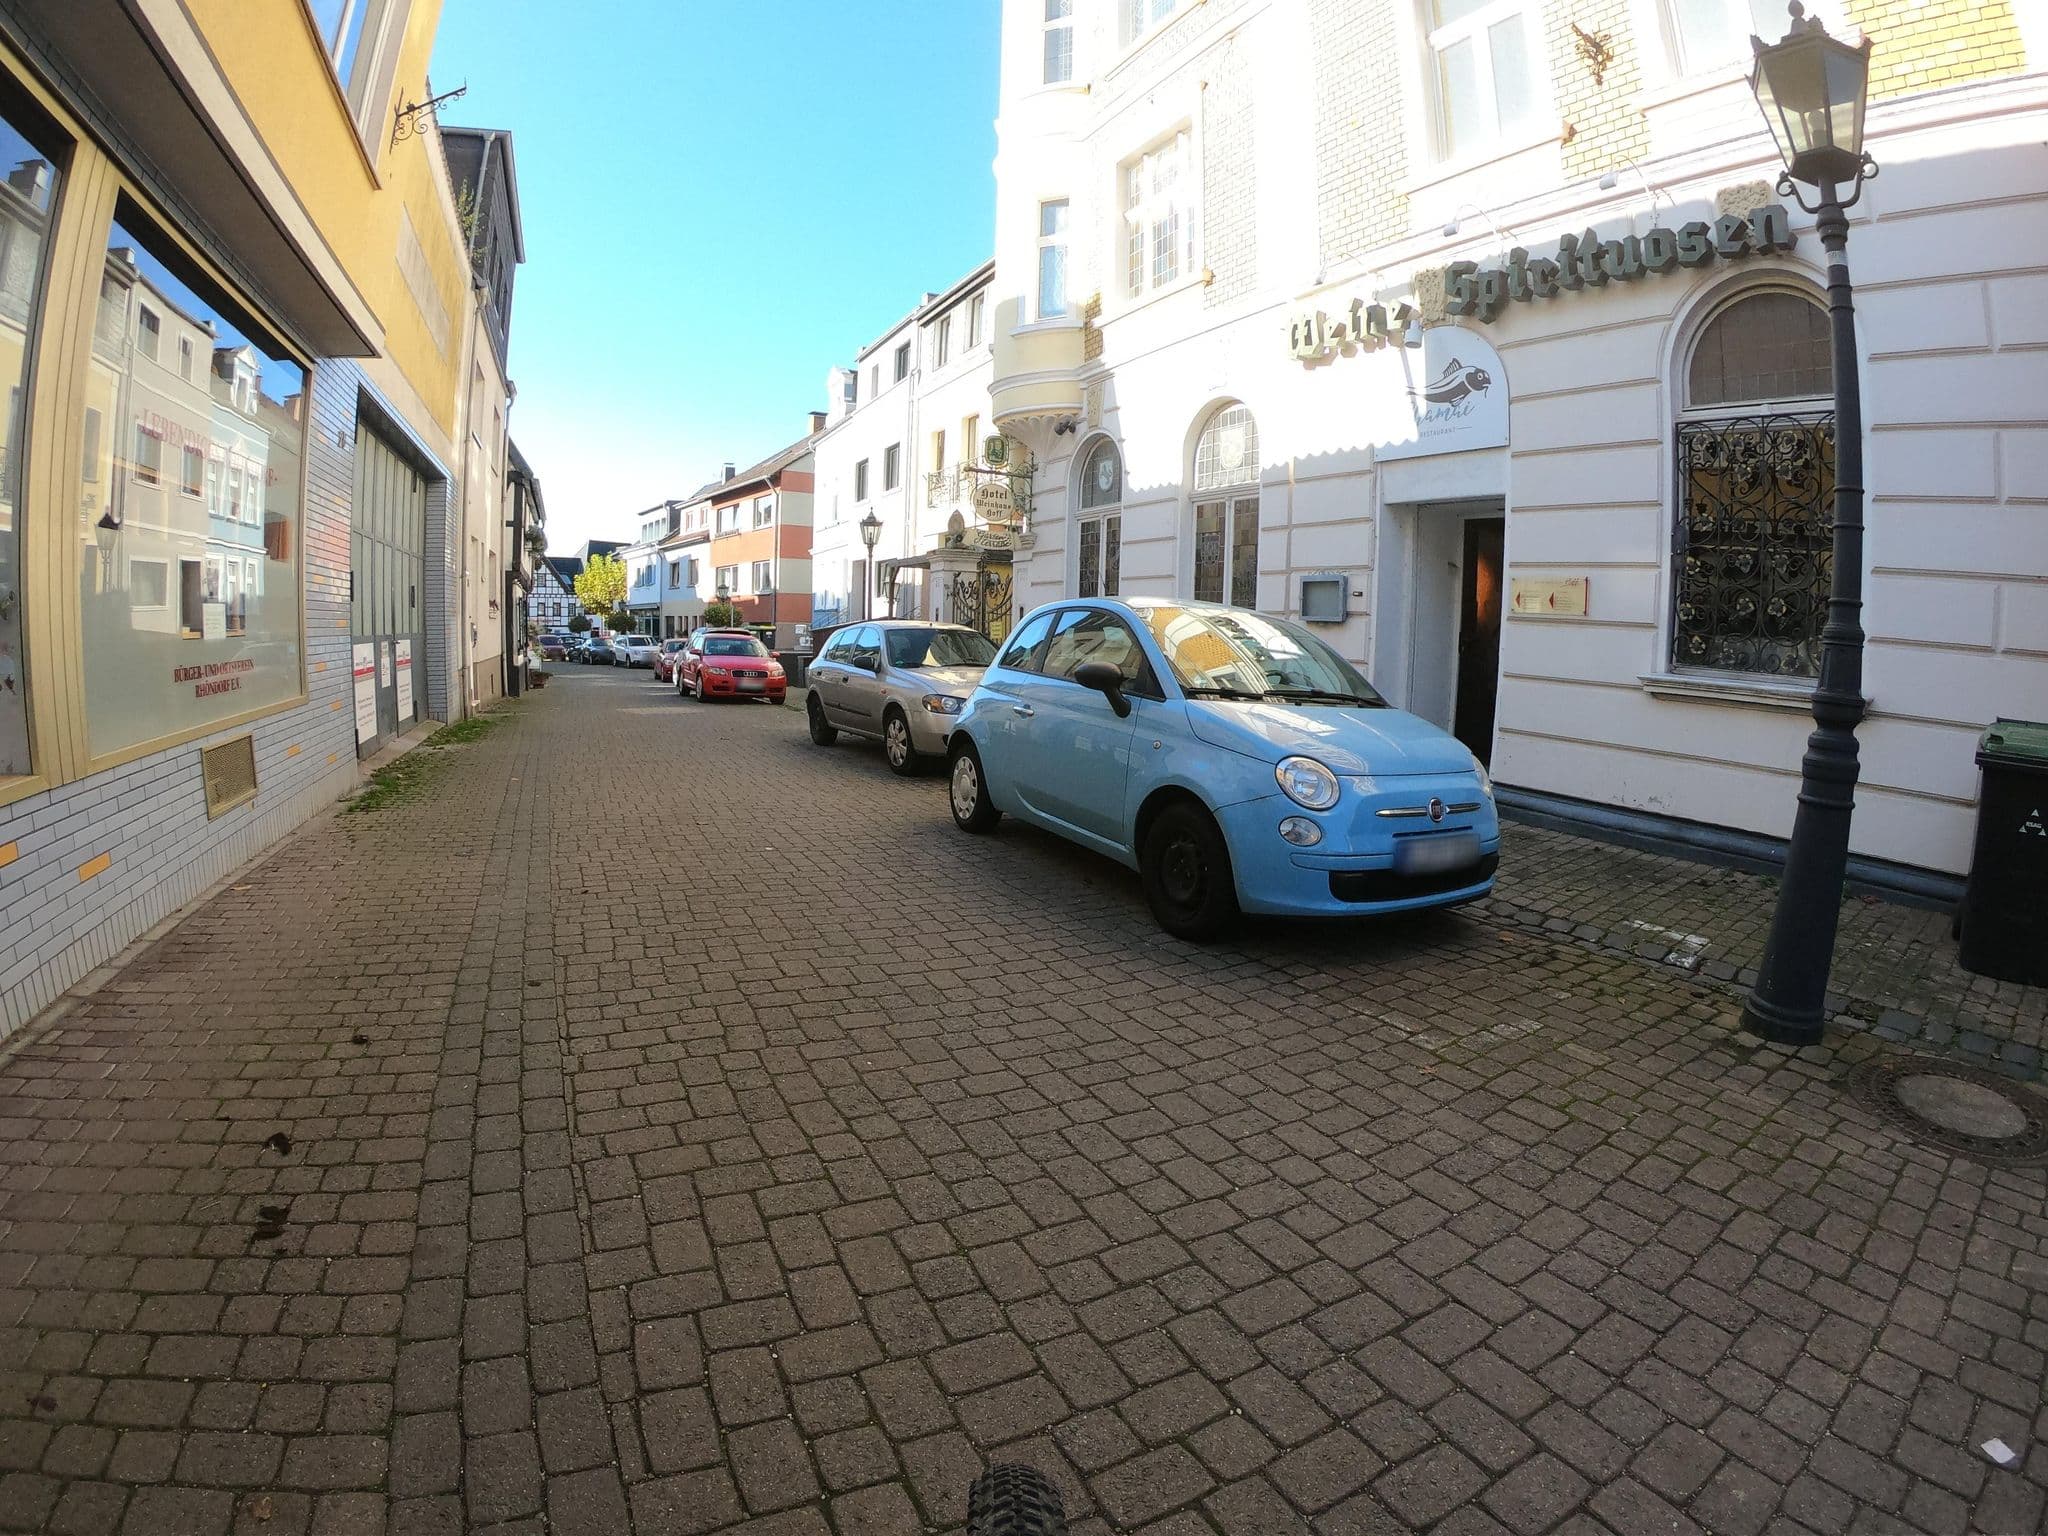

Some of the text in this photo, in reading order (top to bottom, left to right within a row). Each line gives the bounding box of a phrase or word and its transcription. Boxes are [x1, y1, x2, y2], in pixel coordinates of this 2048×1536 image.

[1444, 203, 1798, 325] Spirituosen
[981, 488, 1008, 500] Hotel
[976, 499, 1011, 510] Weinhaus
[986, 509, 1003, 517] Hoff
[195, 680, 230, 697] RHÖNDORF
